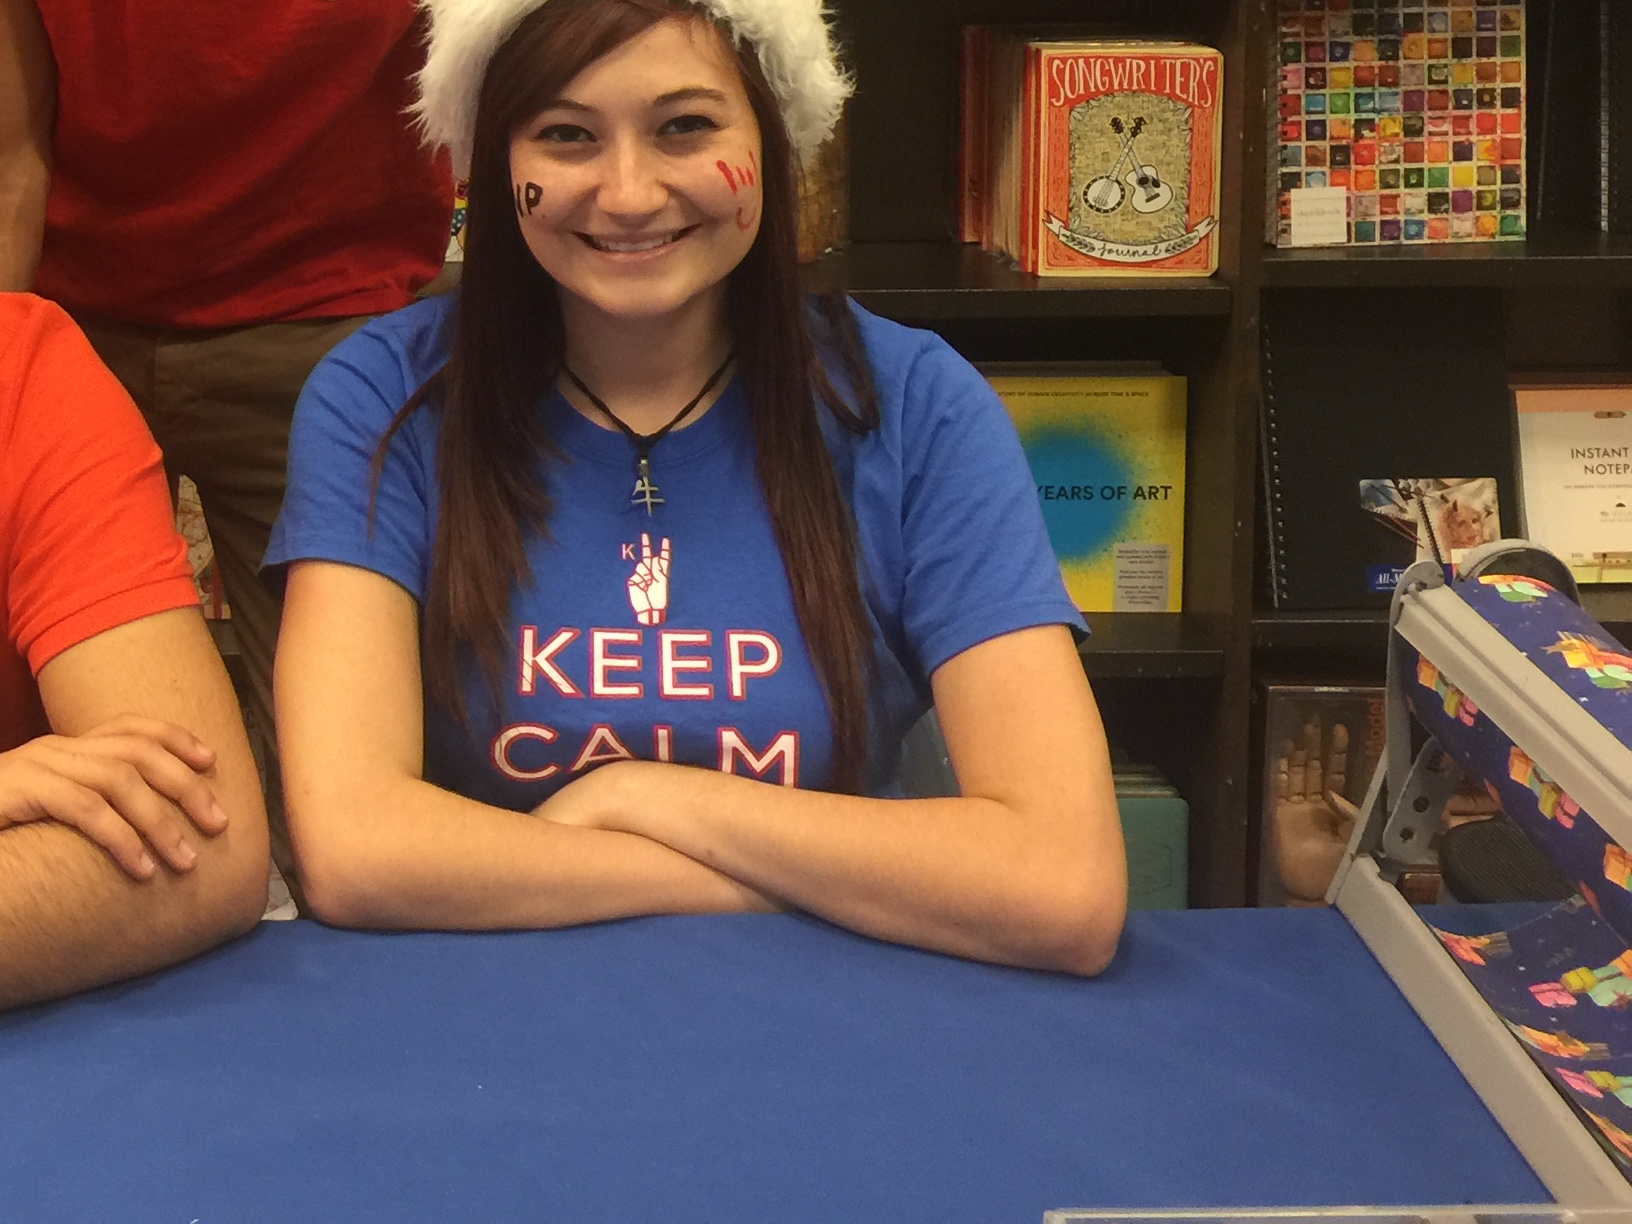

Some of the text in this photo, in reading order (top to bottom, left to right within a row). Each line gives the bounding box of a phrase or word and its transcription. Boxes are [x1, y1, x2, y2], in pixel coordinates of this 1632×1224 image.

[1050, 58, 1215, 108] SONGWRITER'S
[1571, 447, 1629, 459] INSTANT
[1584, 464, 1632, 475] NOTEP
[1100, 486, 1172, 500] OF ART
[621, 543, 636, 560] K
[518, 625, 782, 700] KEEP
